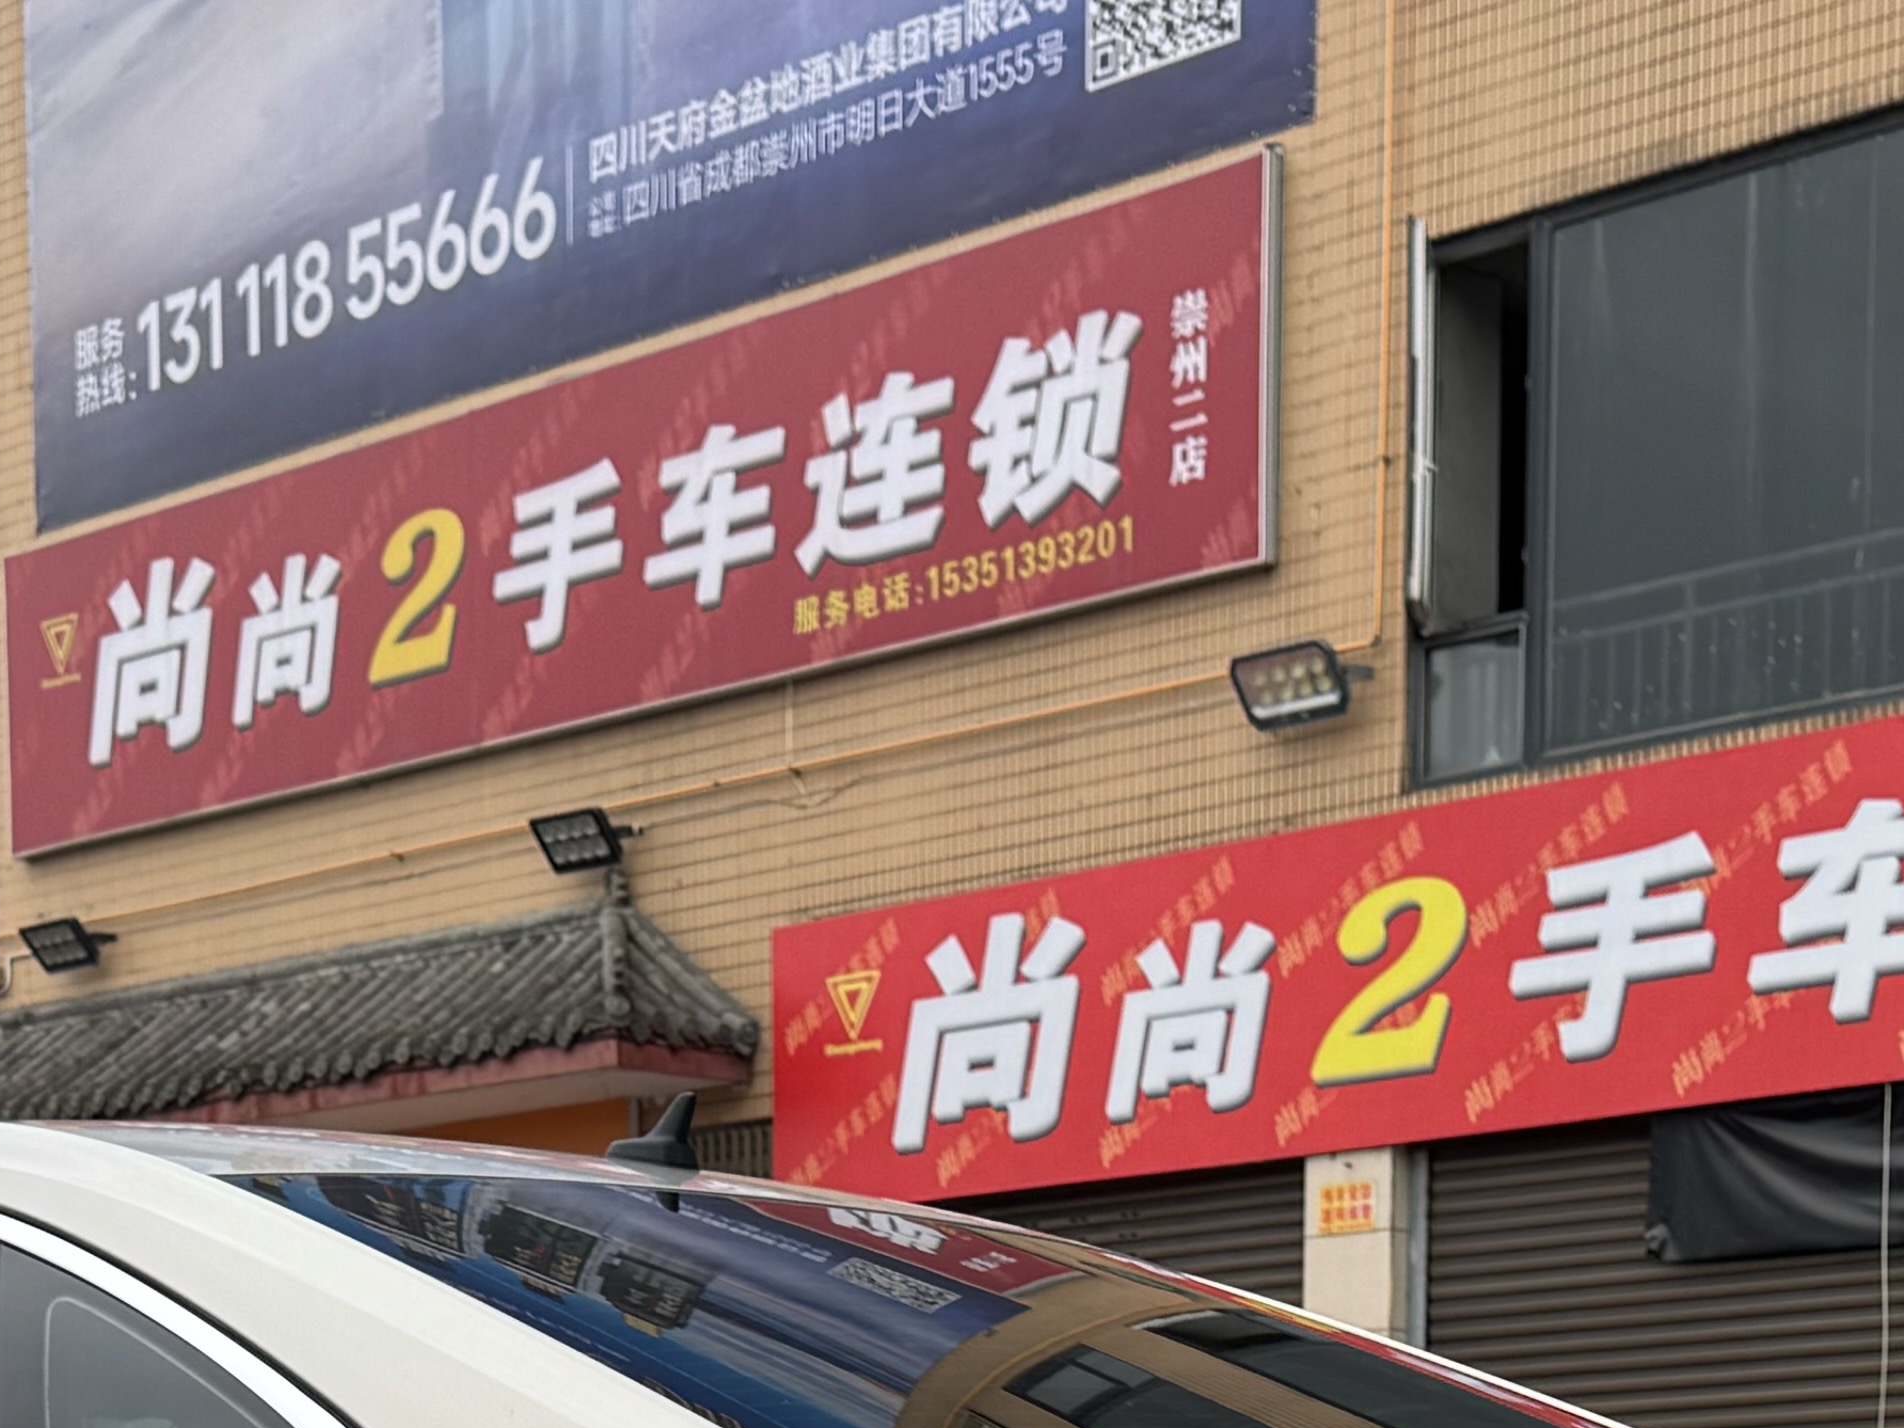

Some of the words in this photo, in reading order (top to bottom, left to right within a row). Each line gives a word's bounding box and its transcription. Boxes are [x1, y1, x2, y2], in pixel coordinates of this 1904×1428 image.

[73, 317, 125, 371] 服务
[137, 276, 224, 392] 131
[345, 156, 557, 320] 55666
[1168, 286, 1209, 488] 崇州二店
[88, 310, 1143, 768] 尚尚2手车连锁
